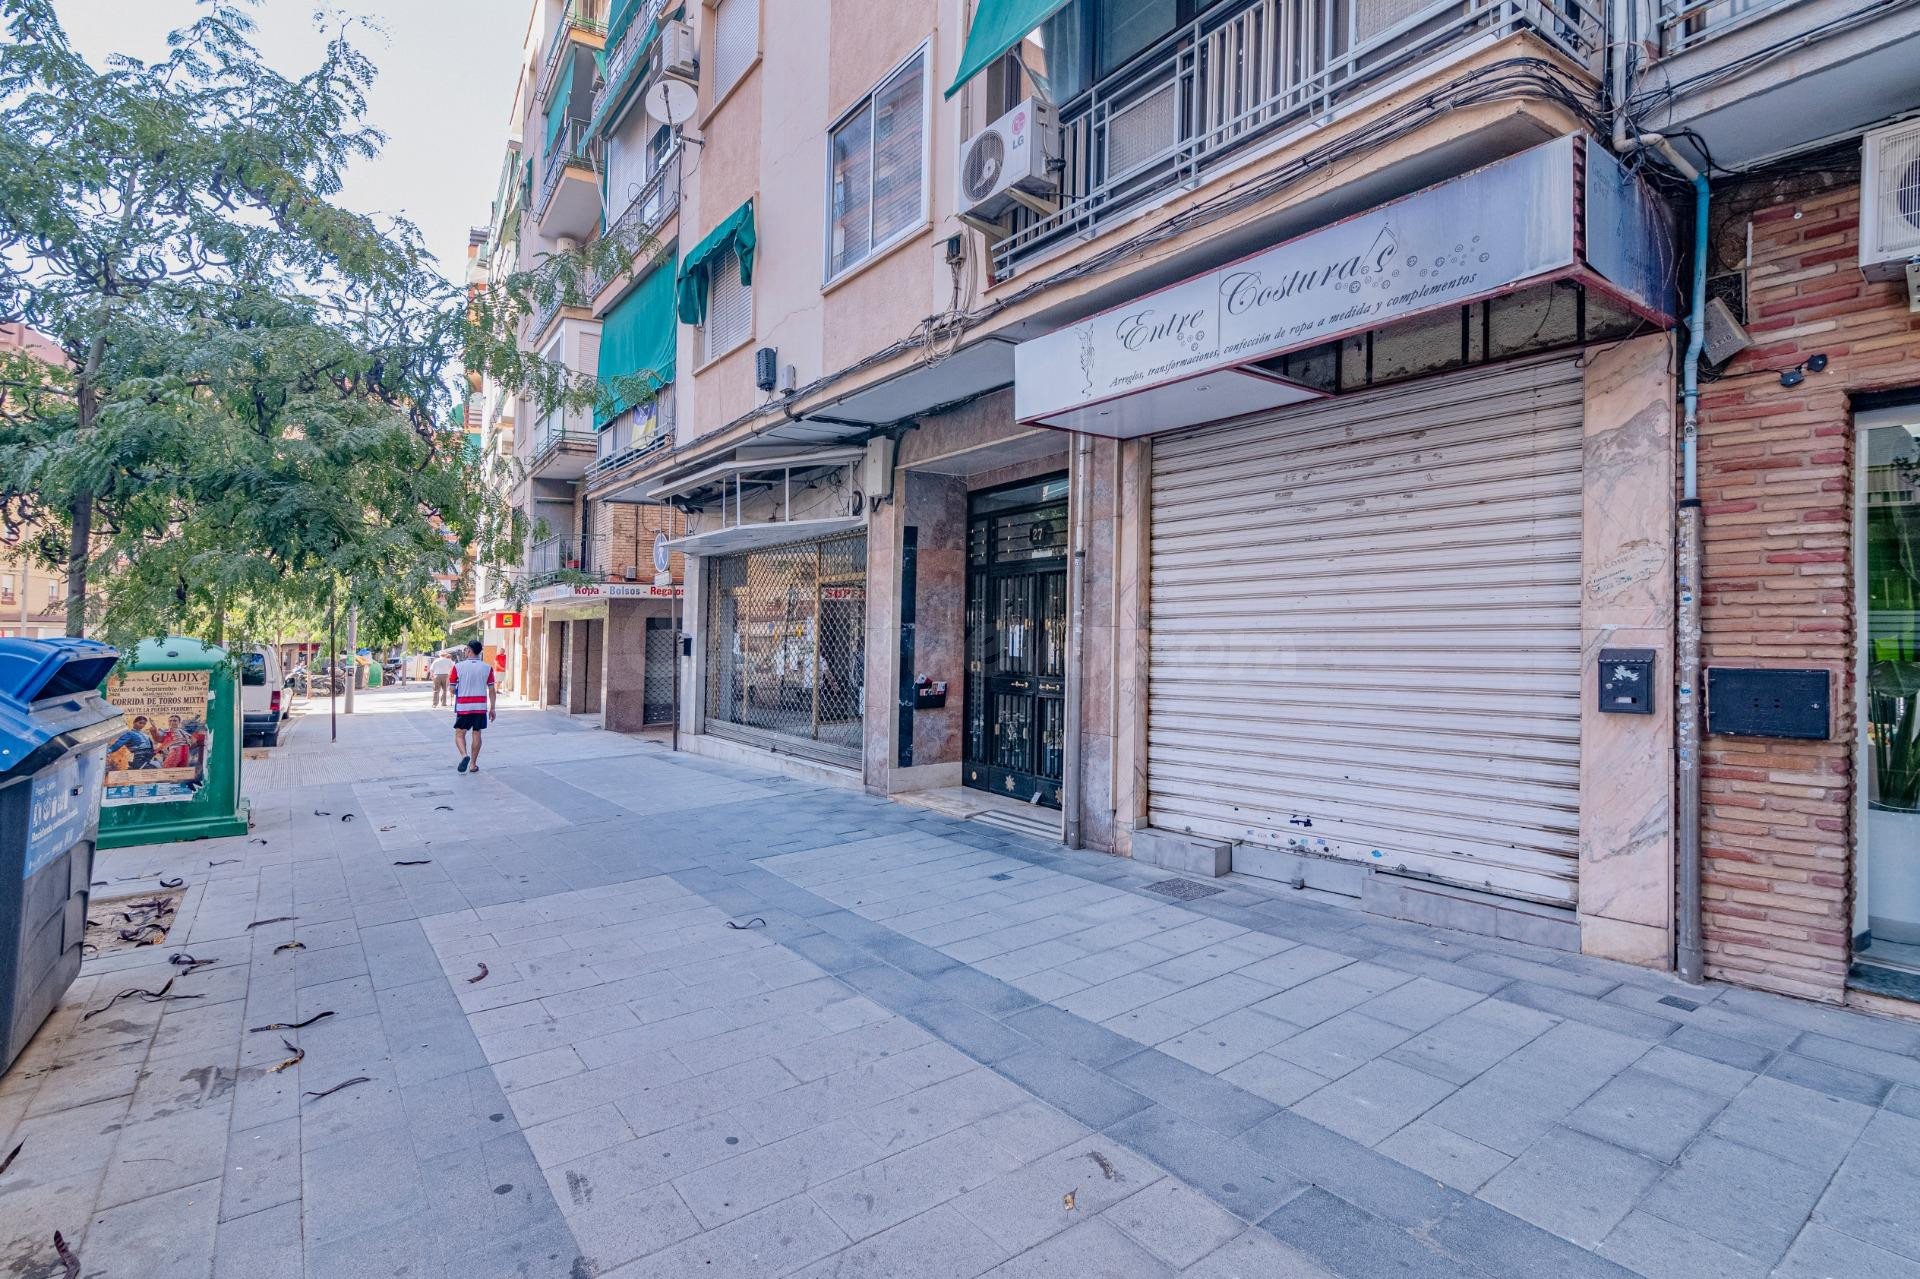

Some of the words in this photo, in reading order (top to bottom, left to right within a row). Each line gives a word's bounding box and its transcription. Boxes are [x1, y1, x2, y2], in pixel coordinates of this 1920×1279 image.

[1013, 135, 1025, 150] LG
[1109, 371, 1145, 388] Arreglos,
[1147, 349, 1220, 376] transformaciones,
[1223, 330, 1273, 355] confección
[1274, 326, 1287, 340] de
[1289, 321, 1315, 338] ropa
[1317, 319, 1326, 328] a
[1329, 303, 1373, 325] medida
[1372, 301, 1383, 316] y
[1387, 273, 1478, 309] complementos
[1116, 309, 1205, 352] Entre
[1032, 528, 1043, 540] 27
[609, 586, 641, 596] Bolsos
[650, 586, 685, 597] Regaos
[151, 673, 199, 683] GUADIX
[112, 698, 146, 706] CORRIDA
[159, 697, 182, 705] TOROS
